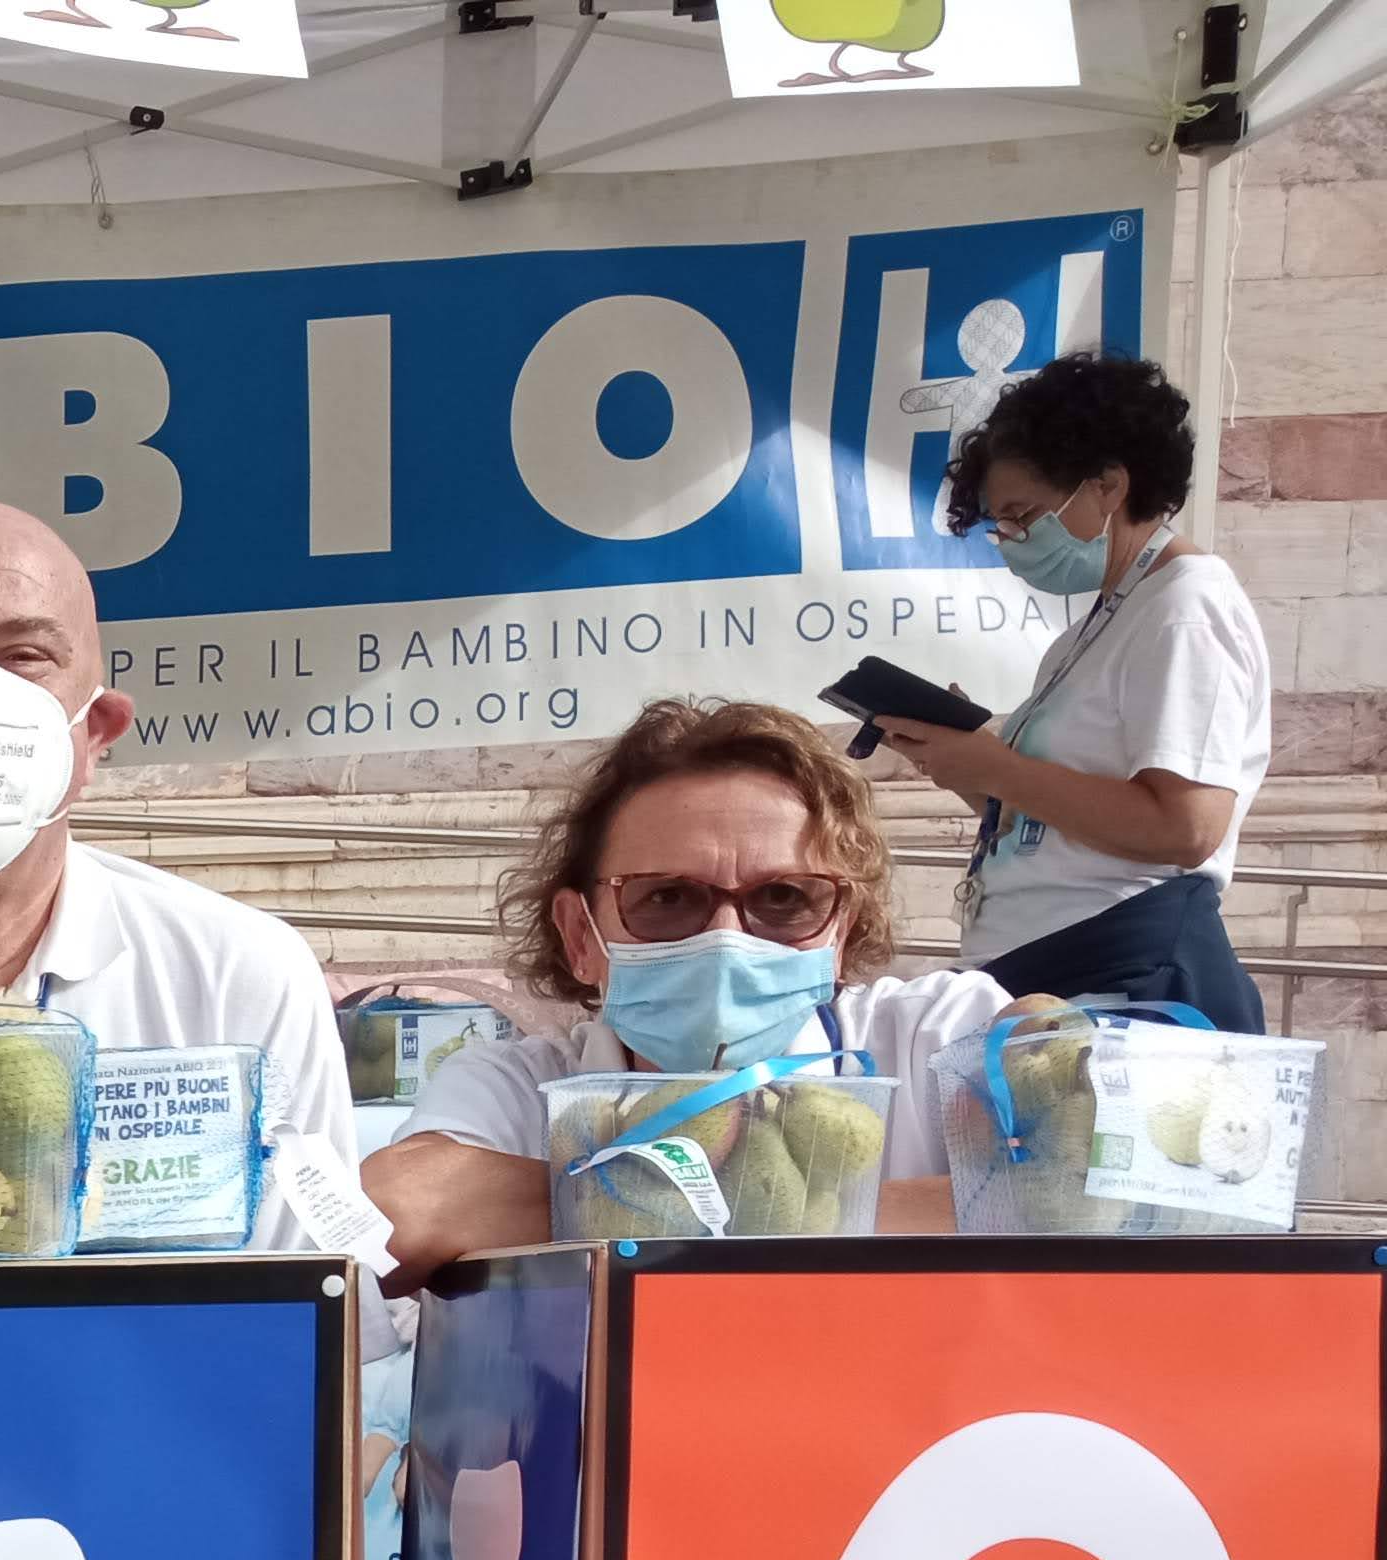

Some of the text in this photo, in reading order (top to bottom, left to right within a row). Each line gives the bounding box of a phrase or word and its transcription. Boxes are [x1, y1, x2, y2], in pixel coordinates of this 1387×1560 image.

[110, 642, 225, 688] PER
[270, 637, 313, 680] IL
[358, 612, 663, 673] BAMBINO
[698, 606, 757, 650] IN
[116, 1065, 172, 1078] Nazionale
[1276, 1067, 1293, 1083] LE
[94, 1082, 137, 1101] PERE
[176, 1076, 229, 1095] BUONE
[95, 1103, 148, 1121] TANO
[167, 1097, 231, 1116] BAMBINI
[118, 1118, 206, 1140] OSPEDALE.
[102, 1154, 203, 1185] GRAZIE
